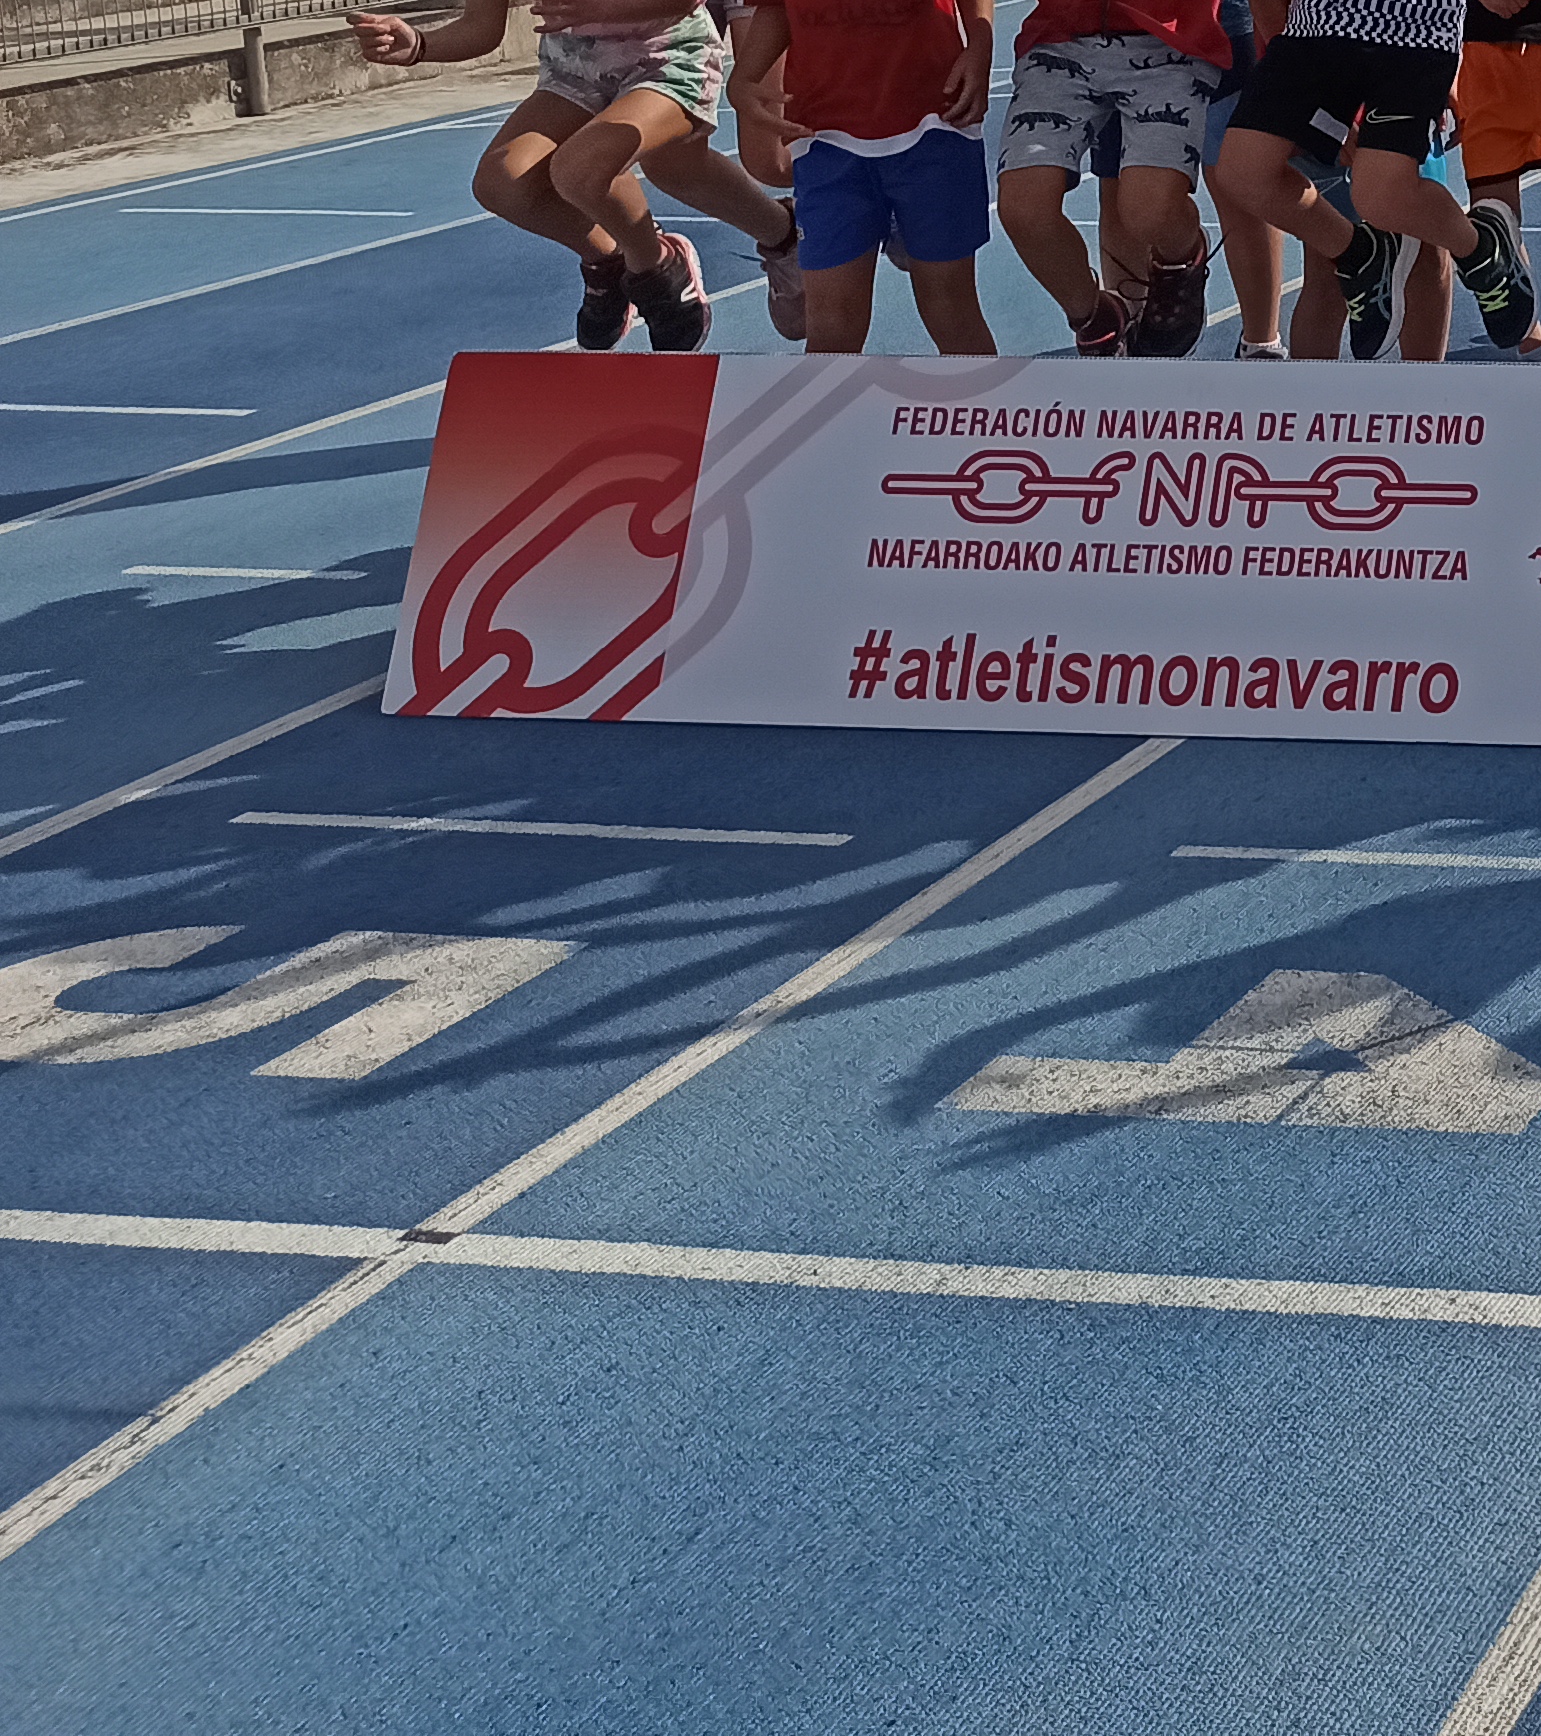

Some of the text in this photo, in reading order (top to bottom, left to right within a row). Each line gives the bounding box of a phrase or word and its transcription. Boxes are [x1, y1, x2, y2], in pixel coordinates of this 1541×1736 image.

[891, 401, 1486, 447] FEDERACIÓN NAVARRA DE ATLETISMO
[867, 537, 1470, 581] NAFARROAKO ATLETISMO FEDERAKUNTZA
[849, 627, 1460, 714] #atletismonavarro
